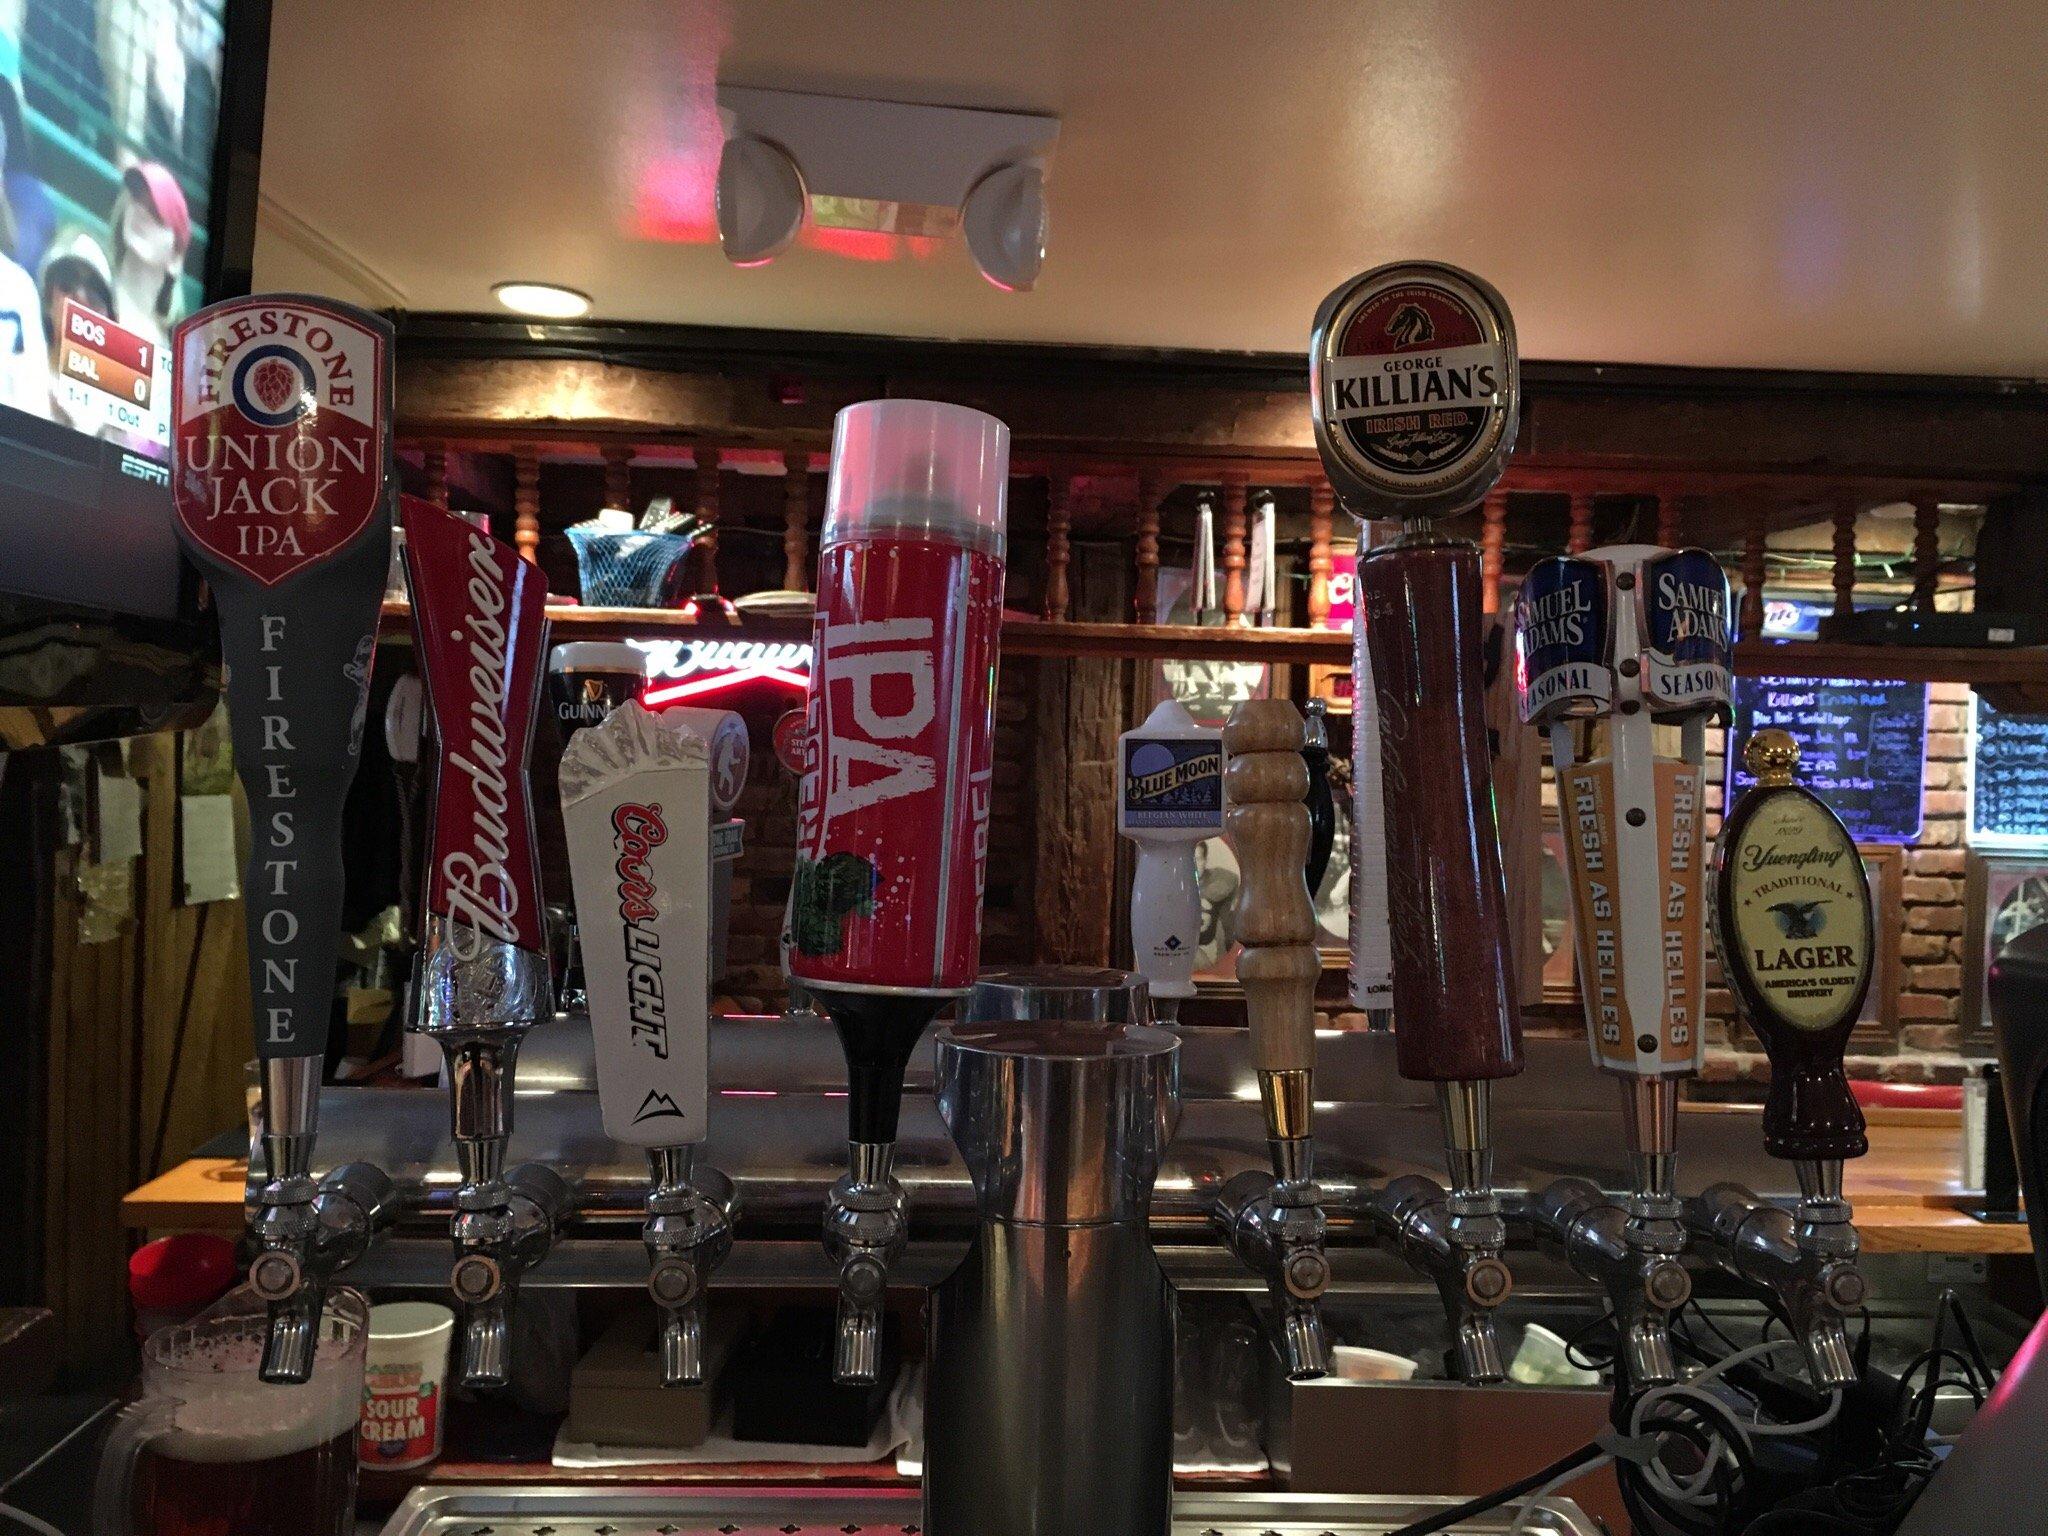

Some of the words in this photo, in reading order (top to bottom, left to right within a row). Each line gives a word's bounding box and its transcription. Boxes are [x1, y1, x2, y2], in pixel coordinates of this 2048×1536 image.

[71, 313, 106, 346] BOS
[138, 346, 148, 368] 1
[199, 310, 355, 406] FIRESTONE
[69, 349, 100, 381] BAL
[134, 378, 146, 401] 0
[1384, 355, 1444, 373] GEORGE
[1335, 365, 1498, 410] KILLIAN'S
[118, 407, 140, 428] Out
[1366, 414, 1421, 434] IRISH
[1429, 411, 1468, 428] RED
[185, 434, 369, 474] UNION
[207, 477, 339, 521] JACK
[236, 525, 305, 556] IPA
[1658, 572, 1727, 619] SAMUEL
[1666, 608, 1729, 653] ADAMS
[558, 701, 611, 720] GUINN
[827, 616, 937, 819] IPA
[443, 532, 520, 961] Budweiser
[1127, 771, 1173, 800] BLUE
[1175, 757, 1219, 784] MOON
[260, 614, 298, 1044] FIRESTONE
[1573, 776, 1604, 873] FRESH
[1670, 774, 1695, 873] FRESH
[611, 802, 668, 926] Coors
[1742, 843, 1844, 872] Yuengling
[1590, 880, 1612, 921] AS
[1667, 880, 1687, 921] AS
[1752, 875, 1844, 898] TRADITIONAL
[1754, 945, 1857, 971] LAGER
[622, 923, 669, 1060] LIGHT
[1596, 929, 1621, 1045] HELLES
[1665, 930, 1689, 1046] HELLES
[1765, 977, 1818, 989] AMERICA'S
[1819, 976, 1856, 987] OLDEST
[1787, 988, 1834, 999] BREWERY
[361, 1416, 426, 1442] CREAM
[366, 1397, 419, 1419] SOUR
